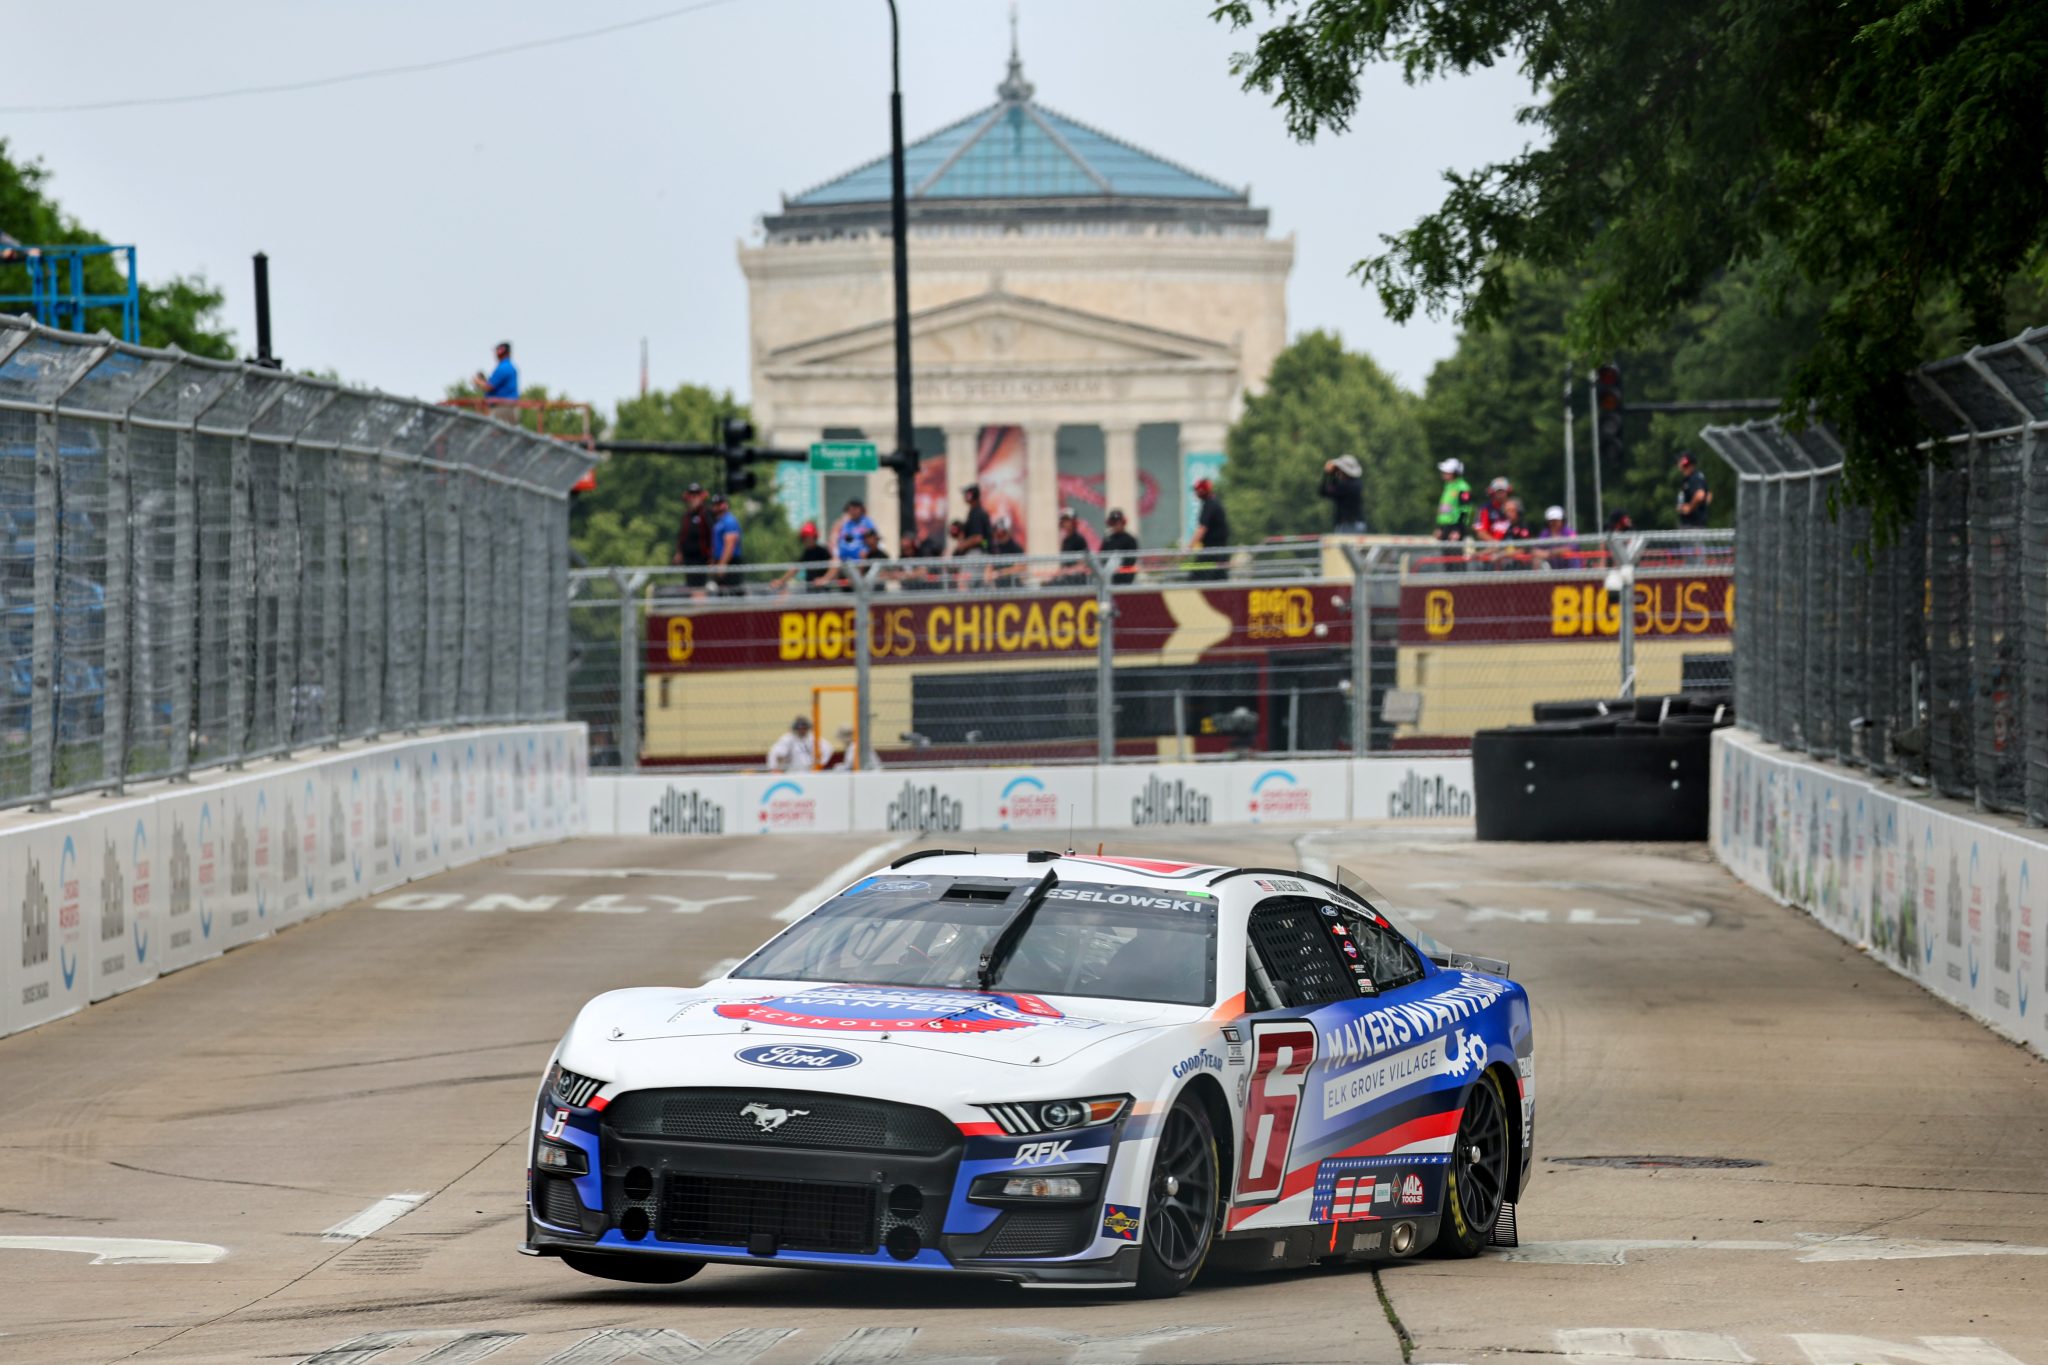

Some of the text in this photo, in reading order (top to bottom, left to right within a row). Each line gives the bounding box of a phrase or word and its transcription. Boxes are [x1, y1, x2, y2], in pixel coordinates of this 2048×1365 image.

[927, 599, 1099, 654] CHICAGO
[374, 893, 756, 913] ONLY
[783, 997, 966, 1013] WANTED
[757, 1046, 838, 1066] Ford
[1172, 1050, 1222, 1079] GOODYEAR
[1328, 1049, 1437, 1108] ELK GROVE VILLAGE
[545, 1109, 571, 1139] 6
[1236, 1027, 1316, 1200] 6
[1012, 1140, 1072, 1165] RFK
[1401, 1175, 1423, 1195] MAC
[1401, 1195, 1423, 1203] TOOLS
